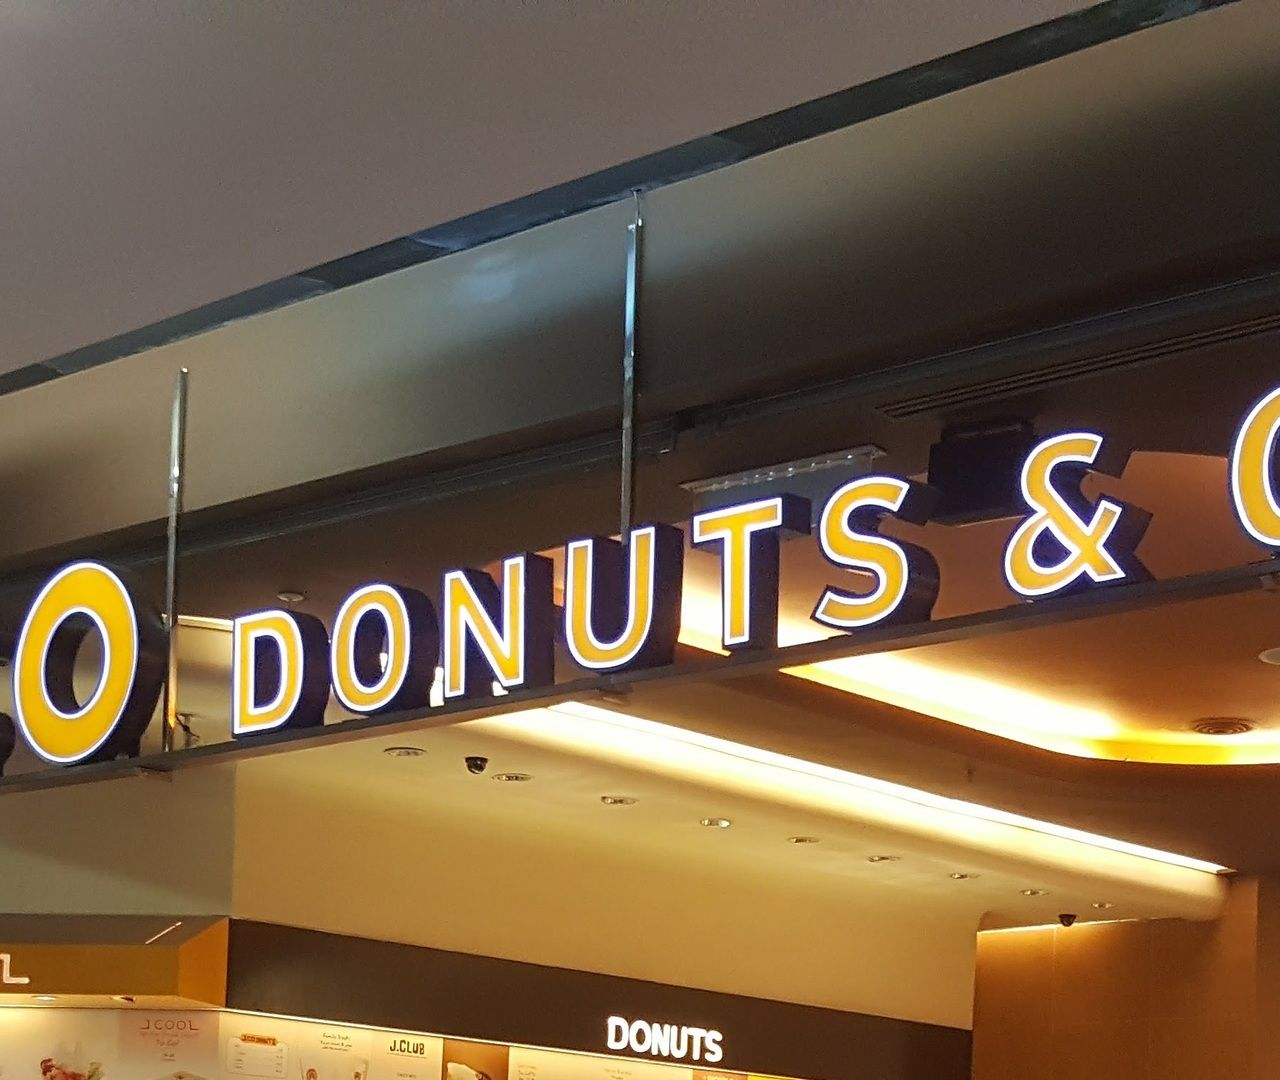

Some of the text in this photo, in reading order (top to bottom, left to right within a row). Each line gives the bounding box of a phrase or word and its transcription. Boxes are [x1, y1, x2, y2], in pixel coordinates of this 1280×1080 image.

[230, 473, 912, 738] DONUTS
[1002, 431, 1127, 600] &
[389, 1039, 426, 1056] J.CLUB
[606, 1015, 725, 1063] DONUTS
